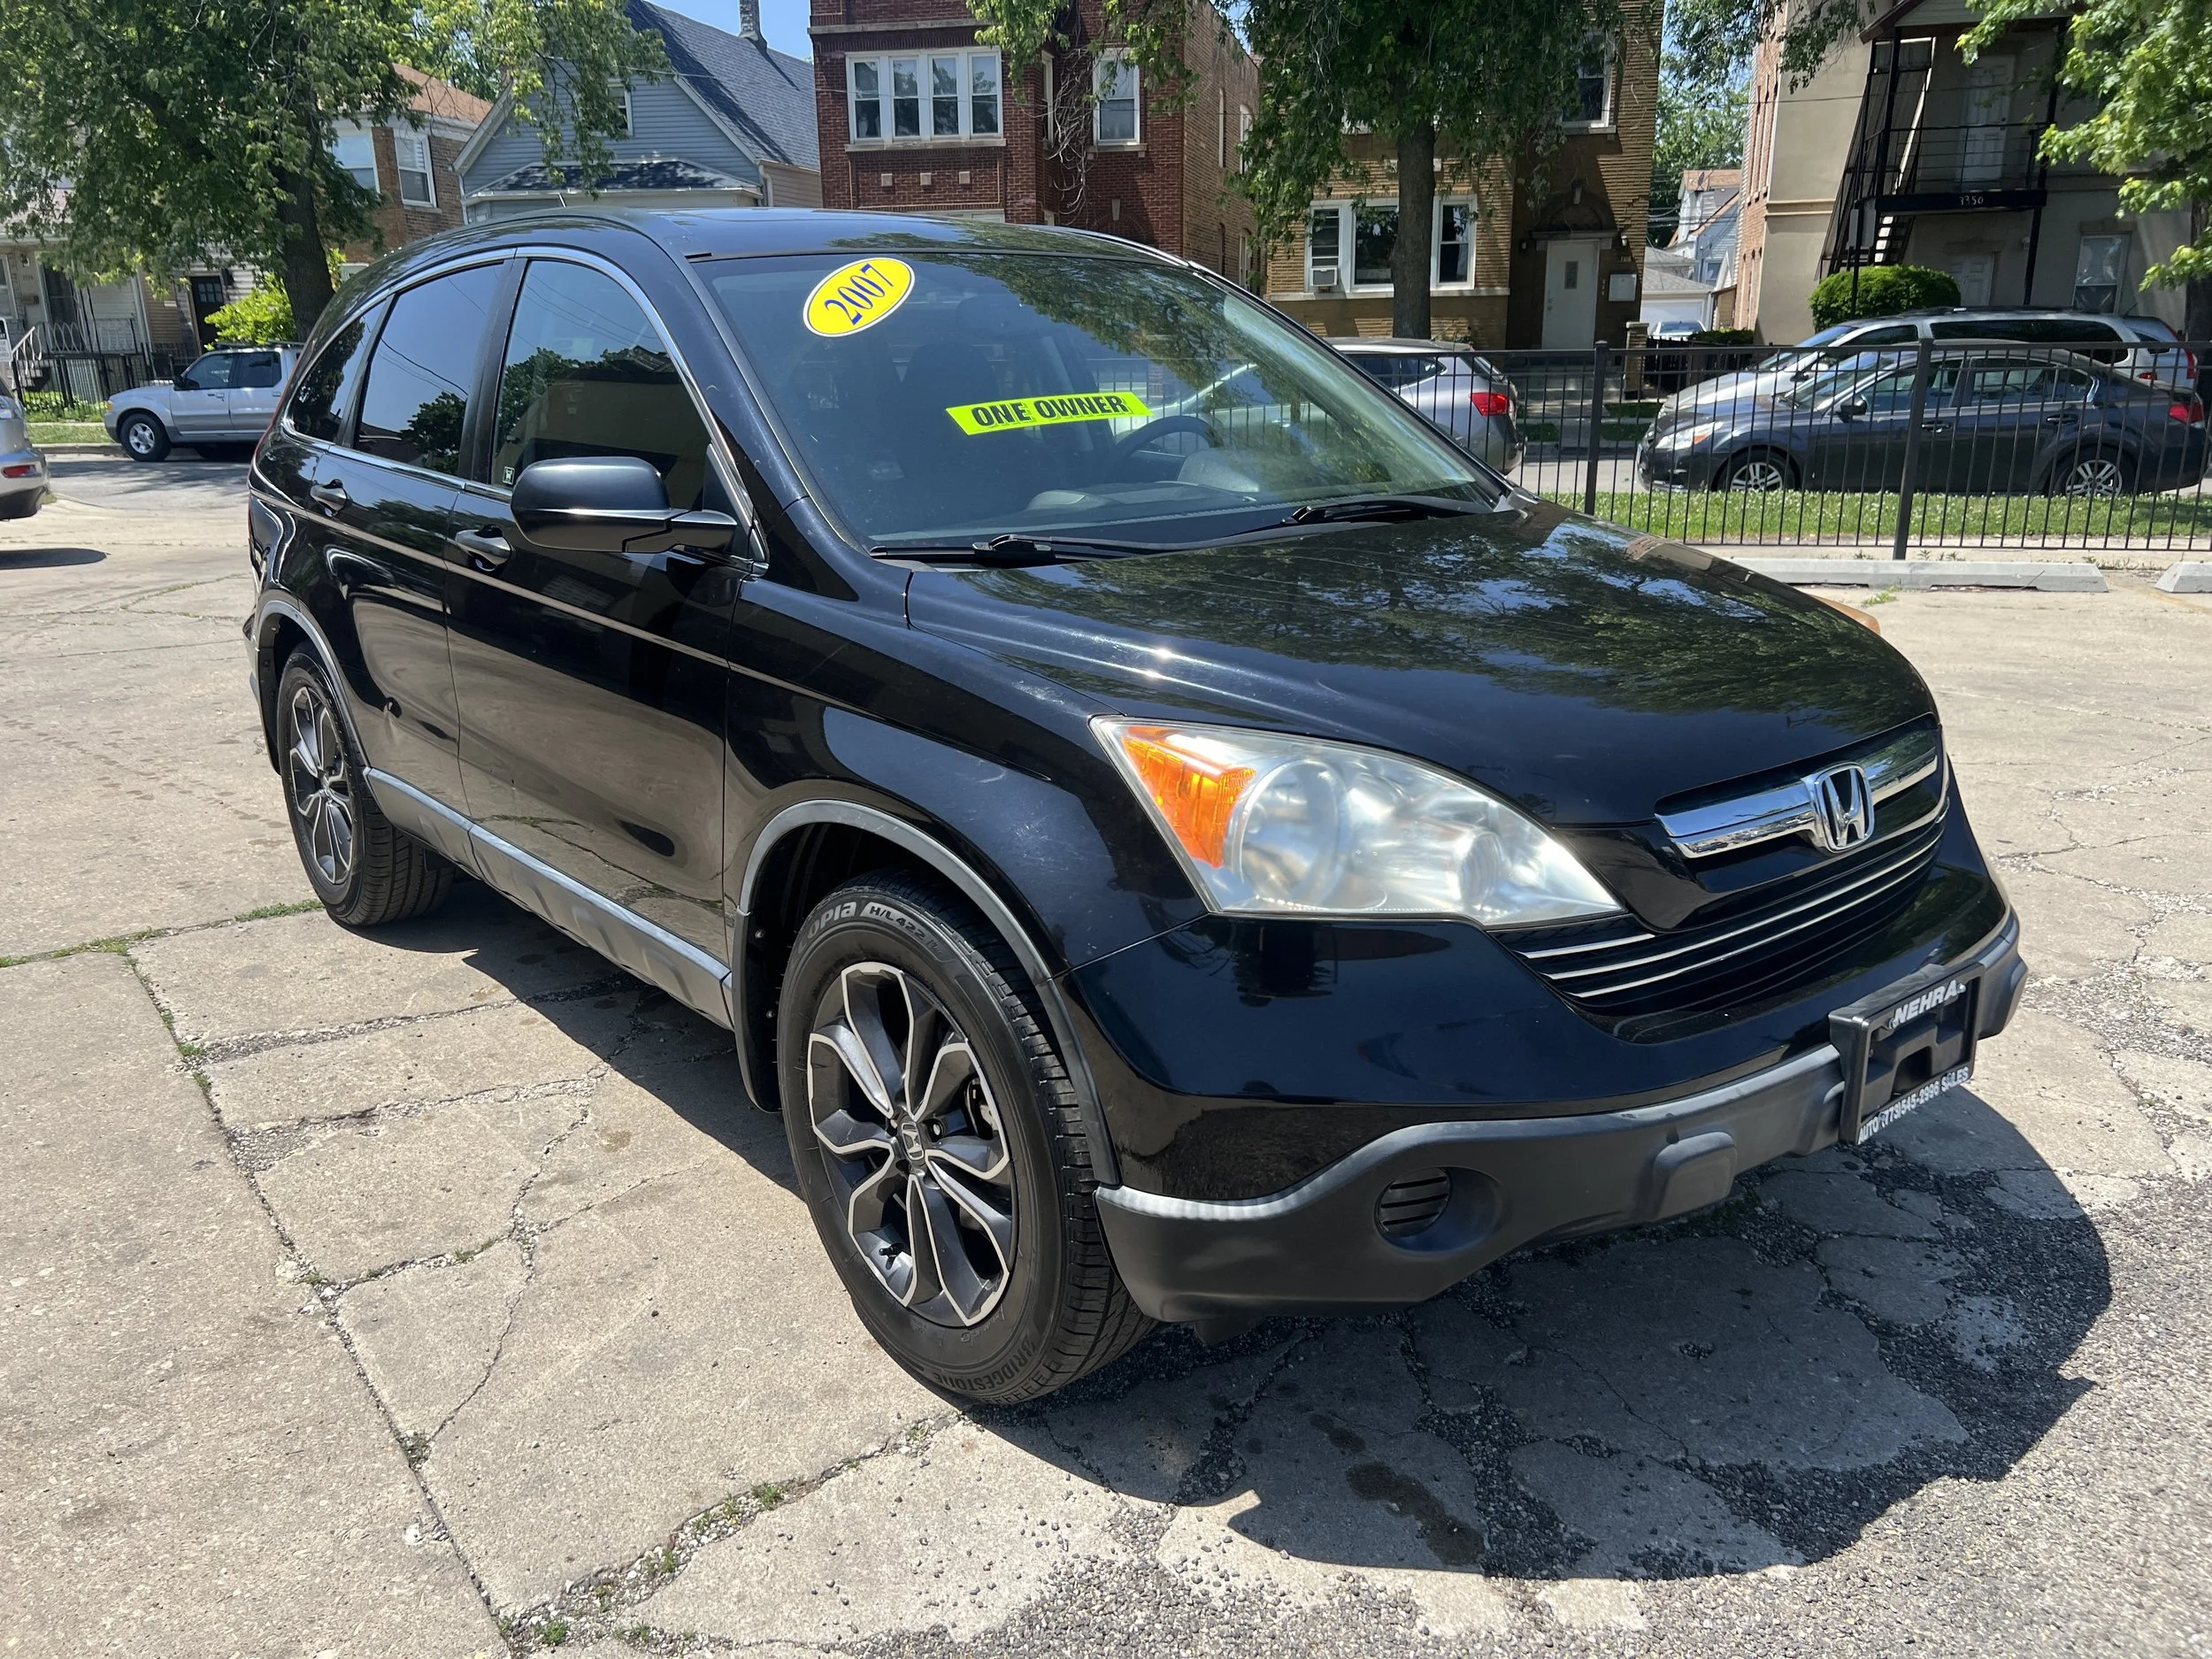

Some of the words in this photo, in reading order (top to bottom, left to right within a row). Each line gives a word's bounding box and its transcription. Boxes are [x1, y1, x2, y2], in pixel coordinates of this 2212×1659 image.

[825, 263, 894, 326] 2007
[972, 402, 1033, 426] ONE
[1033, 395, 1130, 419] OWNER
[1893, 979, 1958, 1024] NEHRA
[1857, 1119, 1879, 1145] AUTO
[1940, 1065, 1970, 1093] SALES
[933, 1335, 1037, 1392] BRIDGESTONE
